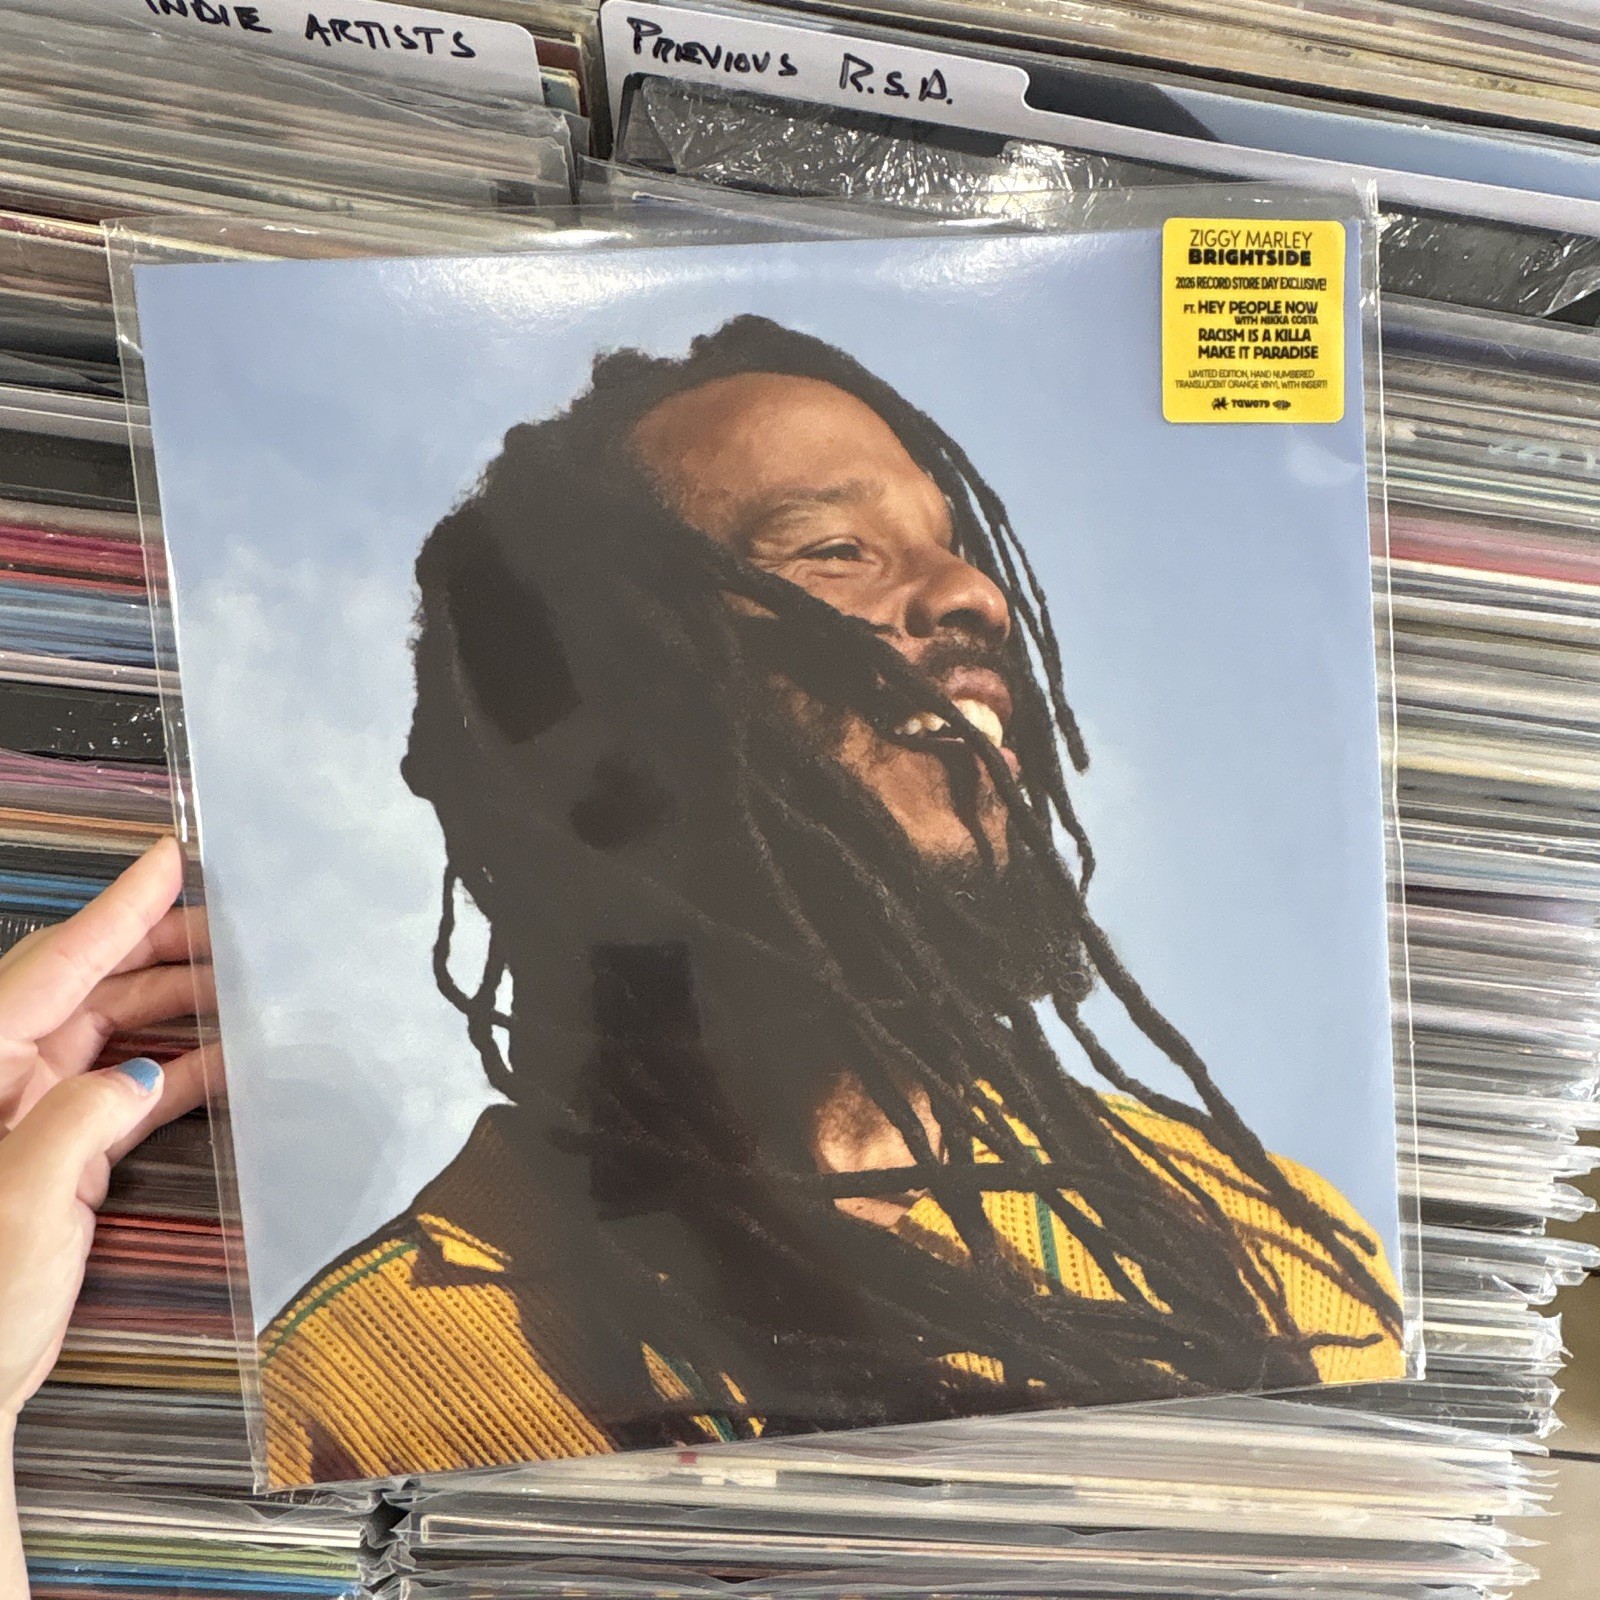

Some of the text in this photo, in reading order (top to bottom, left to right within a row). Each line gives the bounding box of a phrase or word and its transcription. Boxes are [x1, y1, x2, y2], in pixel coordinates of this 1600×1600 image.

[145, 0, 476, 58] INDIE ARTISTS
[1190, 229, 1312, 249] ZIGGY MARLEY
[1188, 249, 1312, 266] BRIGHTSIDE
[1196, 276, 1231, 289] RECORD
[1232, 276, 1260, 290] STORE
[1261, 277, 1280, 290] DAY
[1198, 300, 1225, 314] HEY
[1229, 300, 1282, 315] PEOPLE
[1285, 301, 1318, 315] NOW
[1234, 315, 1259, 325] WITH
[1291, 315, 1319, 325] COSTA
[1198, 328, 1312, 342] RACISM IS A KILLA
[1198, 345, 1319, 360] MAKE IT PARADISE
[1188, 369, 1218, 378] LIMITED
[1250, 369, 1272, 378] HAND
[1272, 369, 1315, 379] NUMBERED
[1175, 379, 1226, 389] TRANSLUCENT
[1227, 379, 1260, 389] ORANGE
[1281, 380, 1300, 389] WITH
